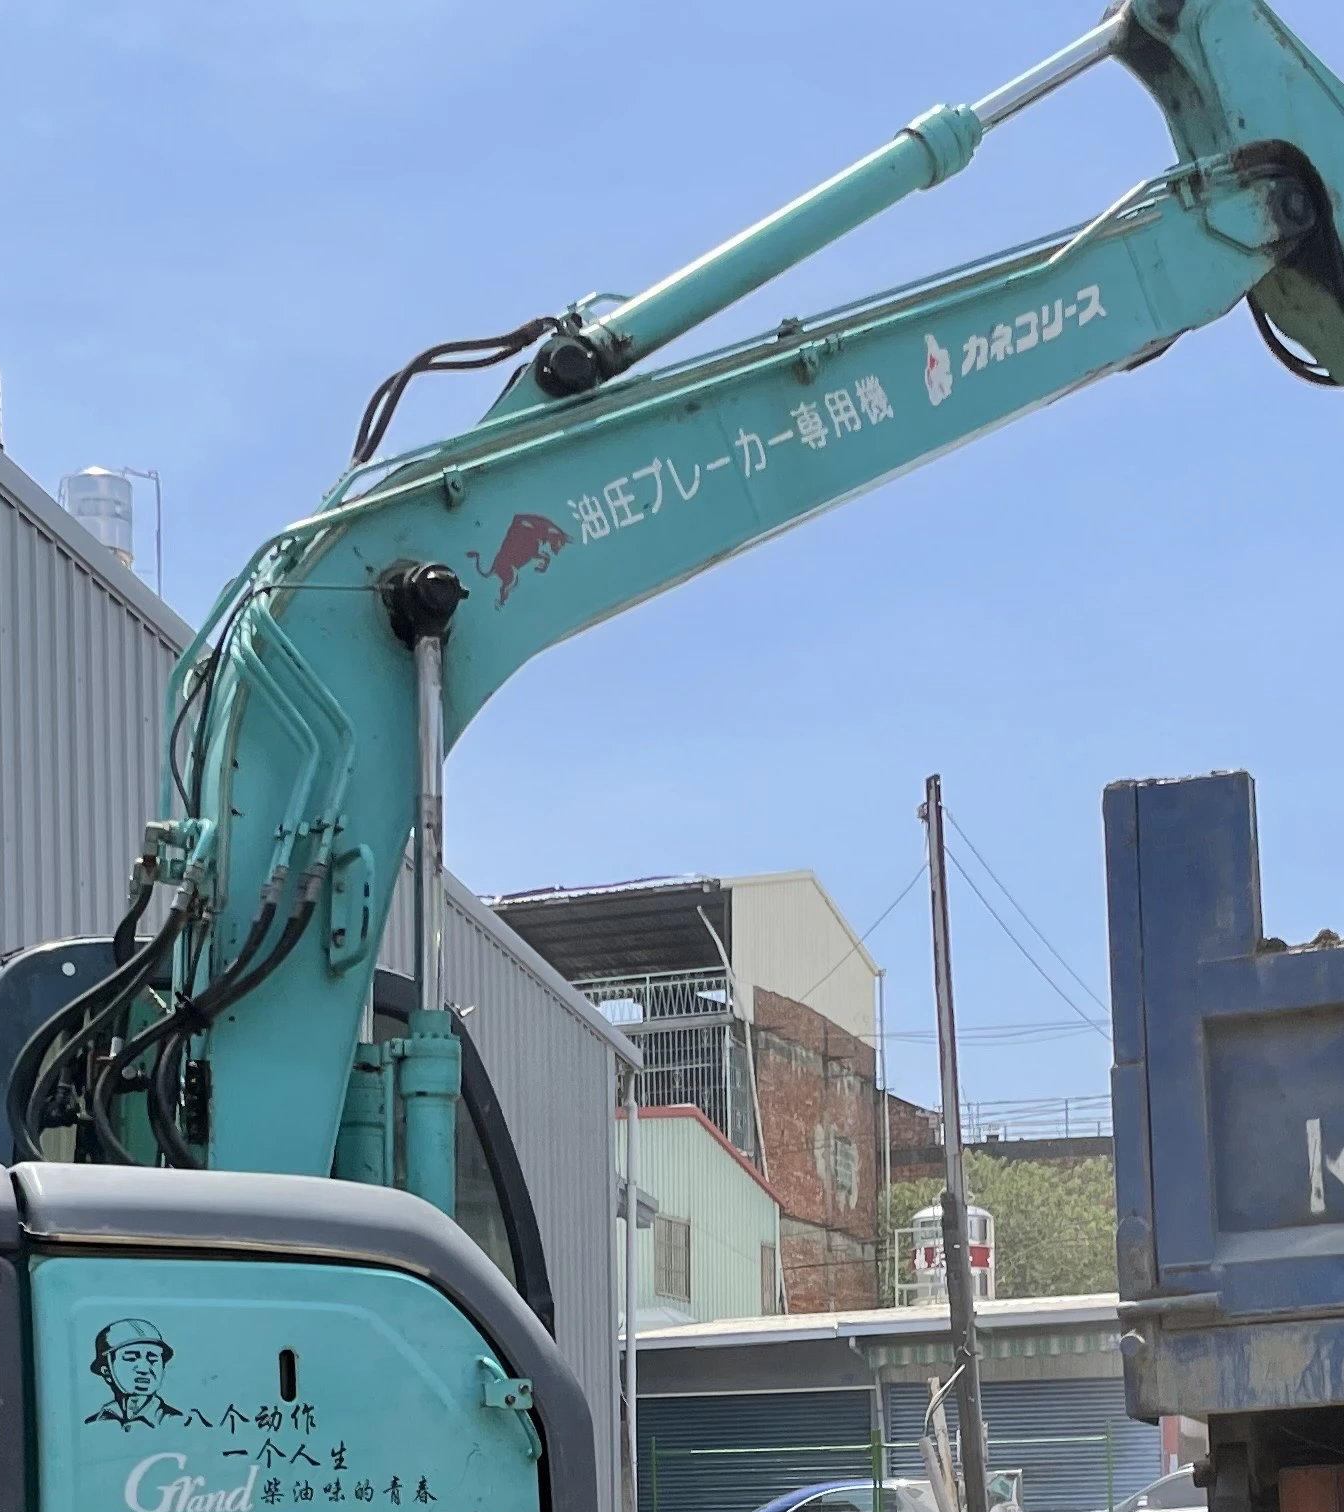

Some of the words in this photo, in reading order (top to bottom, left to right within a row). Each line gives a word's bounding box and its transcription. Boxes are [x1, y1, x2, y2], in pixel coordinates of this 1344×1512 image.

[961, 284, 1107, 377] カネコリース
[184, 1403, 317, 1435] 八个动作
[222, 1438, 348, 1470] 一个人生
[260, 1475, 439, 1506] 柴油味的青春
